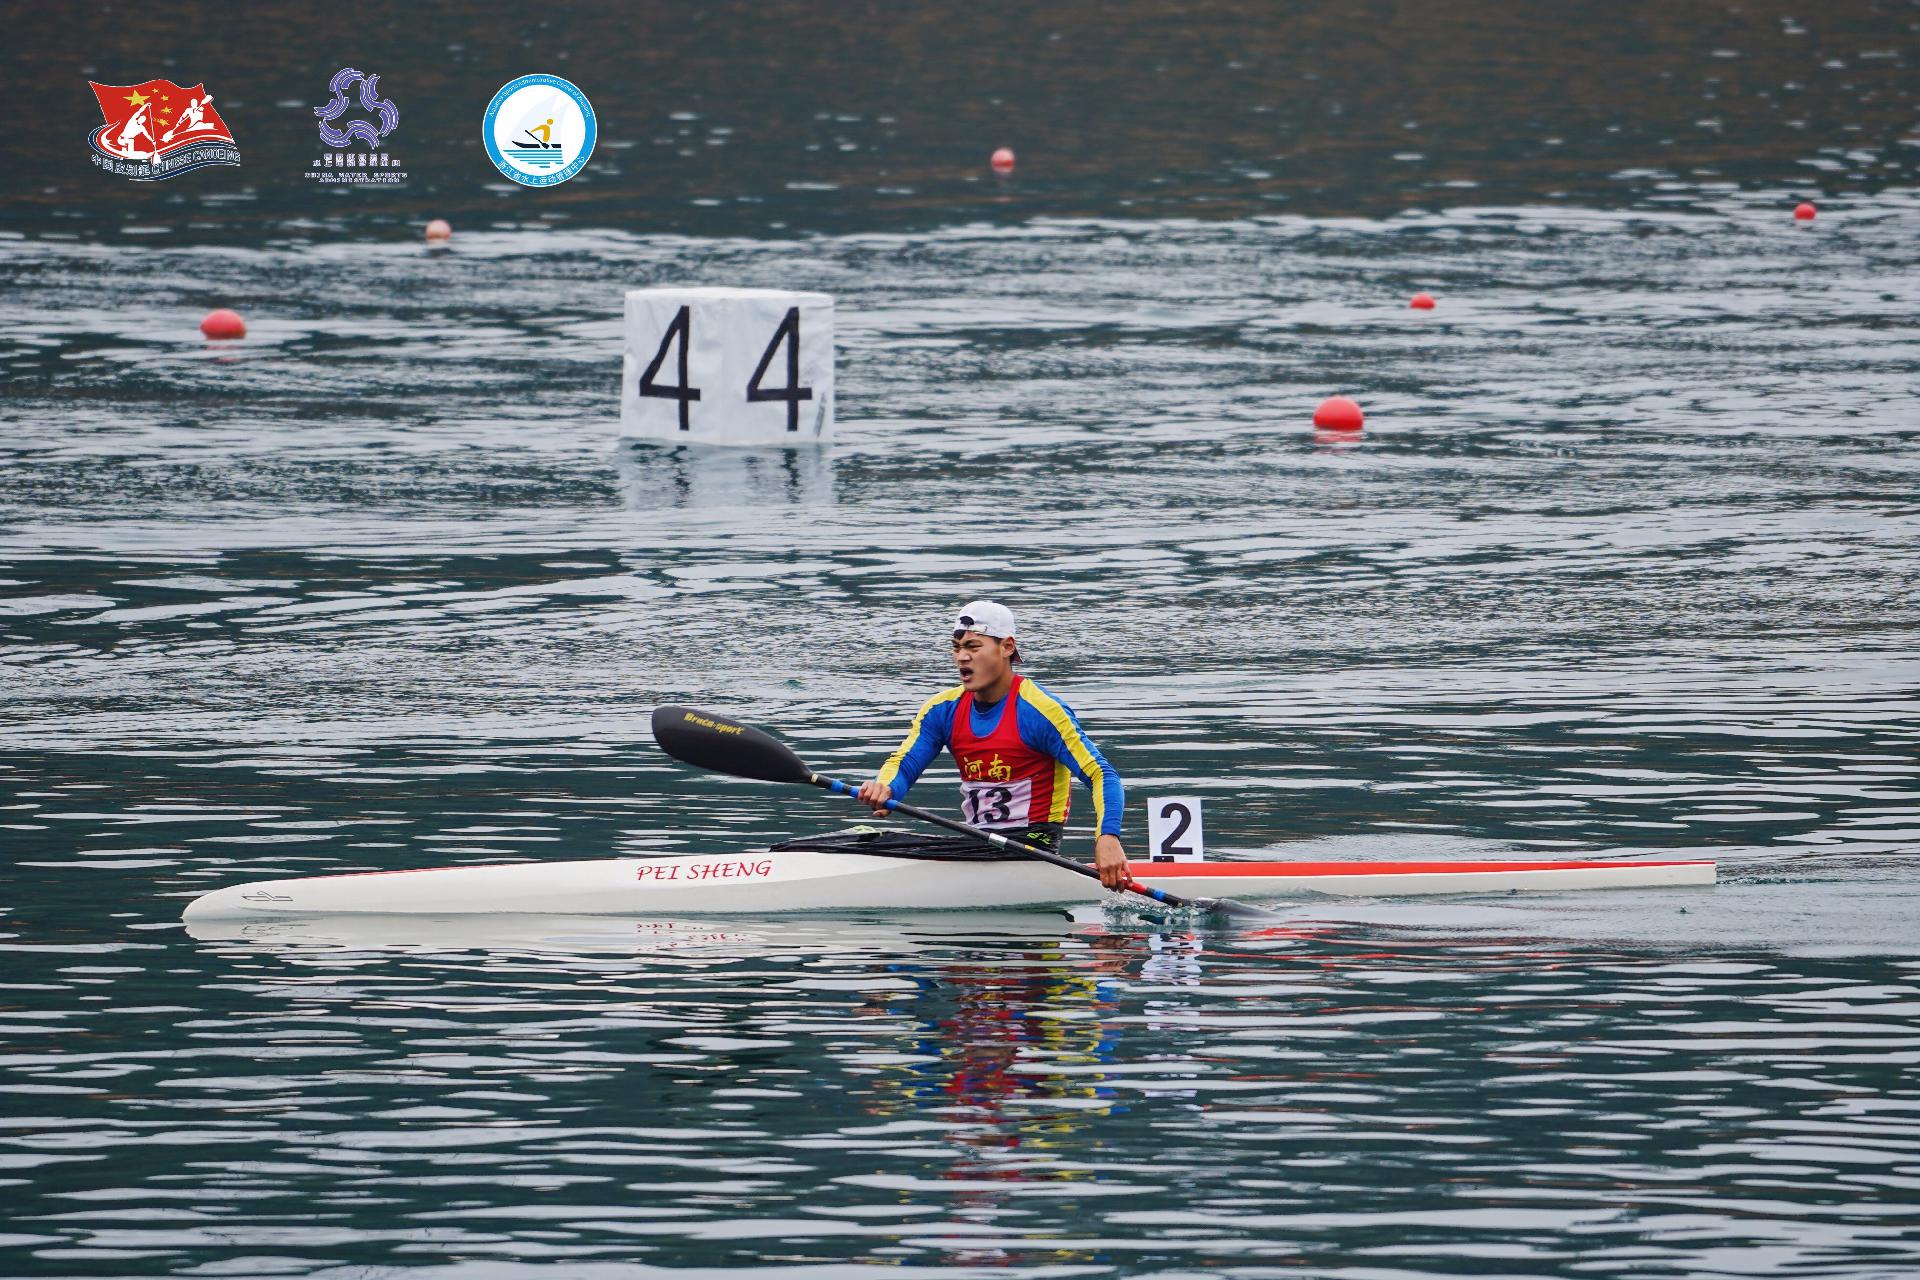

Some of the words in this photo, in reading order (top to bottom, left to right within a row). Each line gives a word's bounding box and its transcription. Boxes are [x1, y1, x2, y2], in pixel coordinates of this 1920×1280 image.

[963, 753, 1012, 782] 河南
[968, 787, 1013, 825] 13
[1160, 802, 1193, 855] 2
[636, 865, 681, 881] PEI
[686, 859, 773, 880] SHENG
